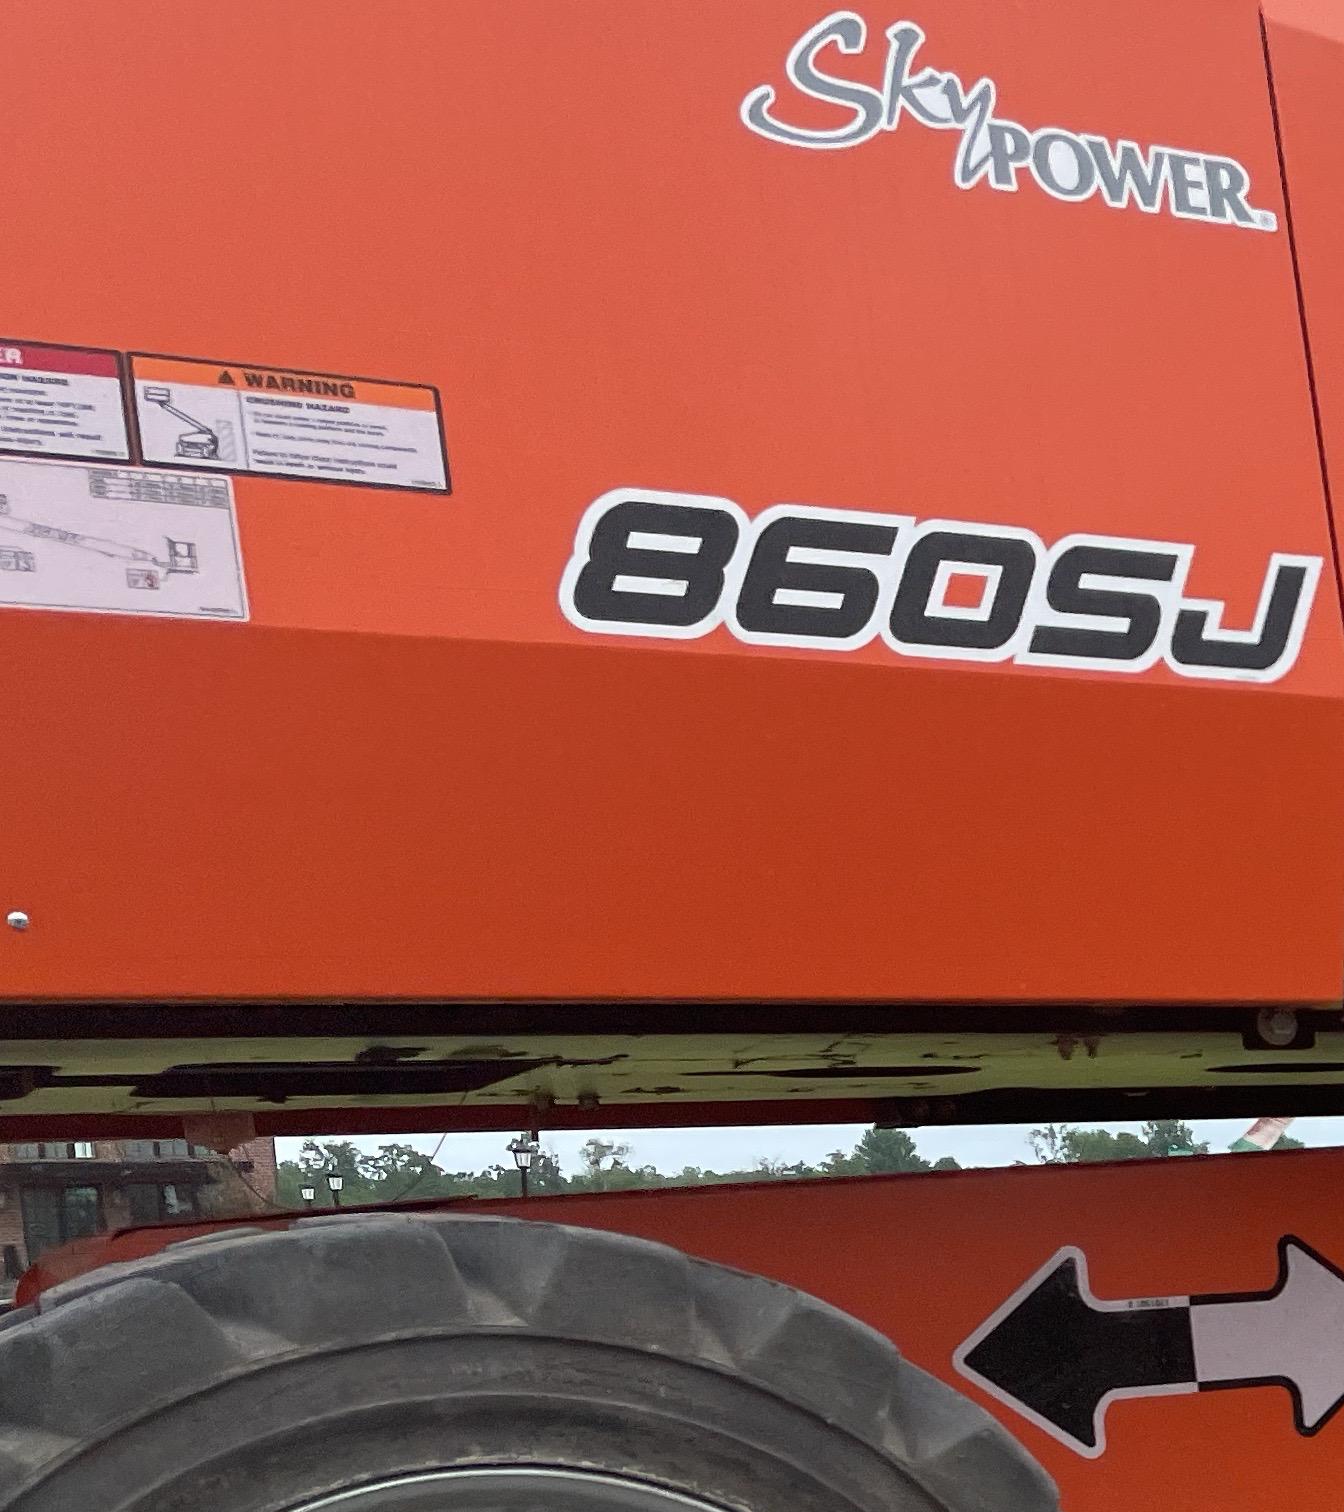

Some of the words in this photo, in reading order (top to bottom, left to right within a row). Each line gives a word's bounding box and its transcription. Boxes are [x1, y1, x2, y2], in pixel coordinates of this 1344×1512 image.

[741, 11, 996, 190] Sky
[986, 121, 1264, 229] POWER
[244, 372, 356, 399] WARNING
[562, 490, 1318, 680] 860SJ
